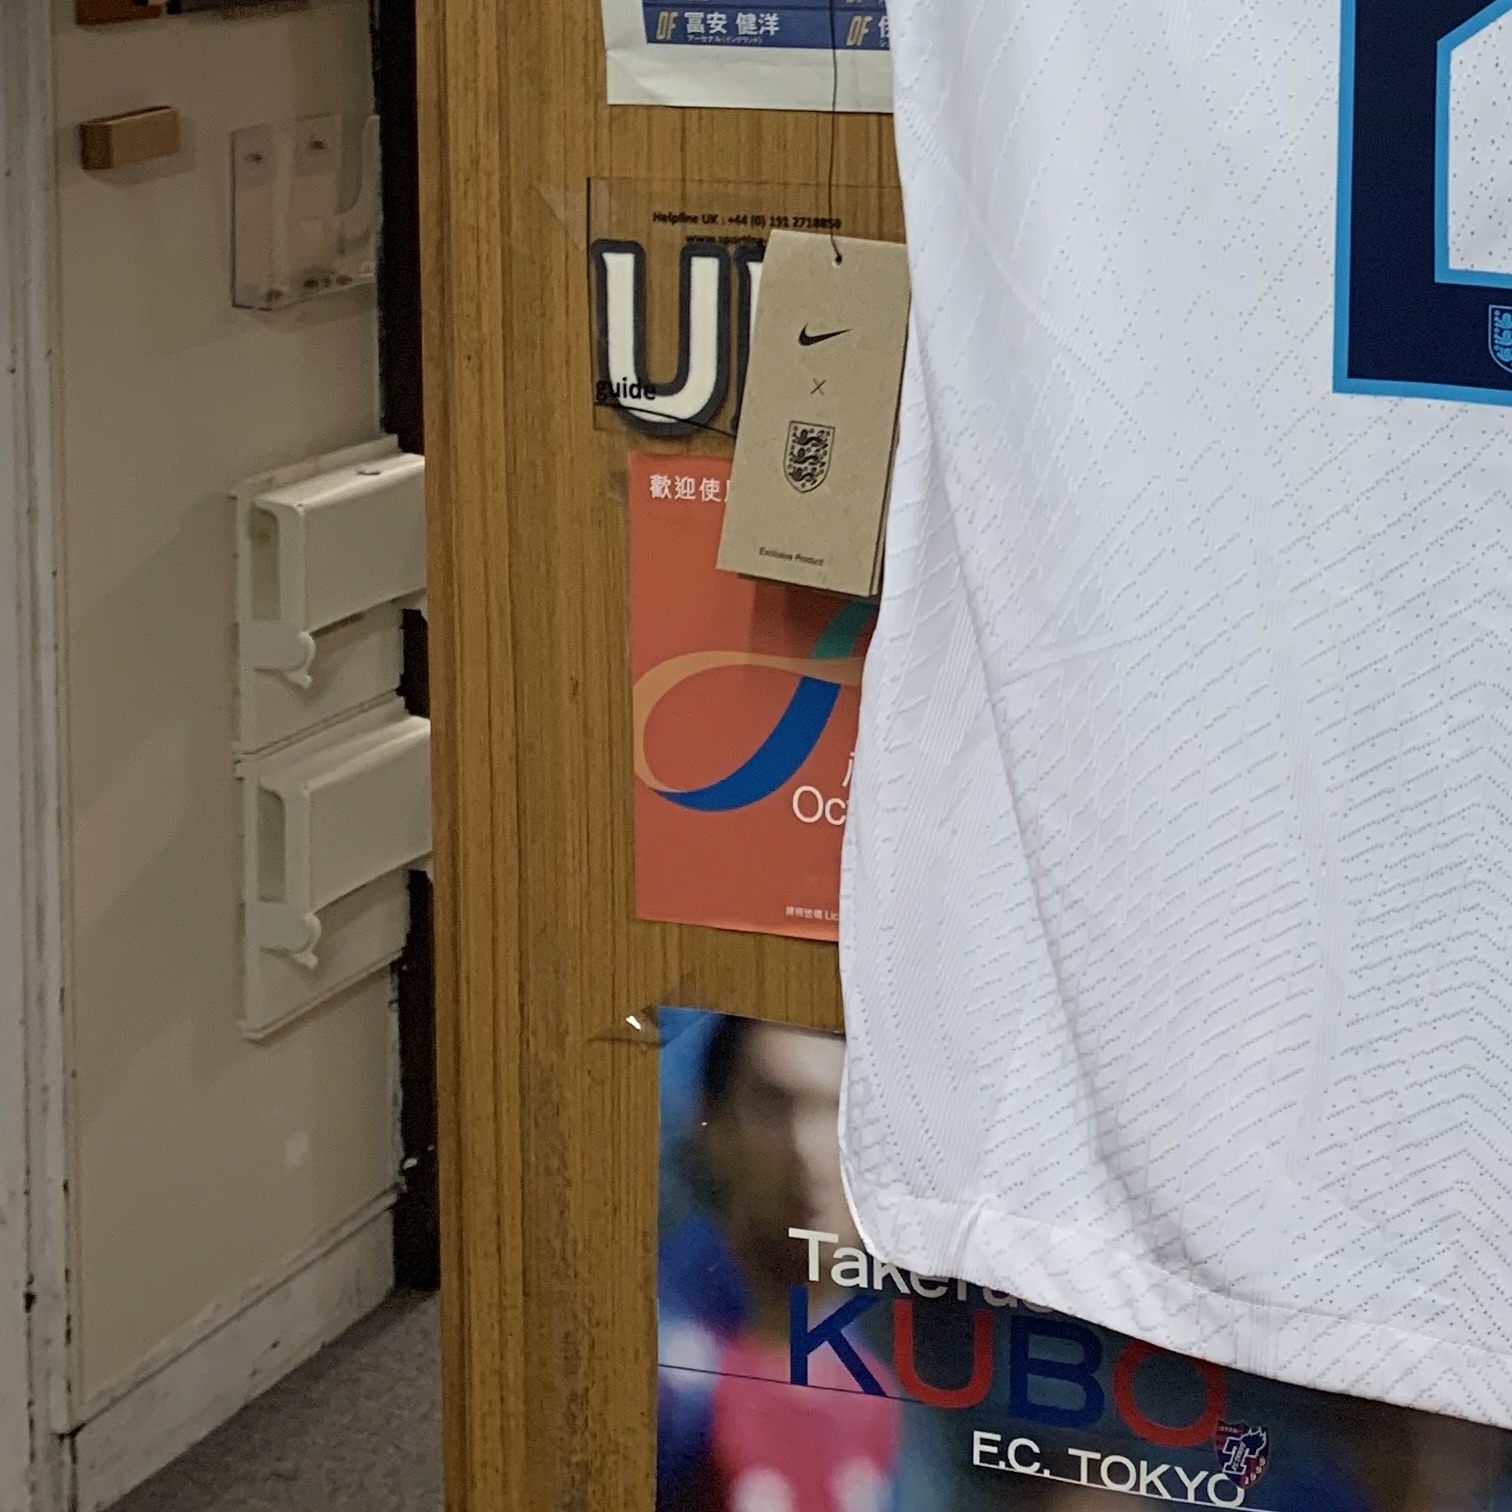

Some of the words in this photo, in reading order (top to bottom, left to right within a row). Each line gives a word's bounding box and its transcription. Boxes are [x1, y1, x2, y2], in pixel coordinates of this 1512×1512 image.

[656, 11, 679, 41] DF
[736, 11, 781, 37] 健洋
[845, 15, 873, 47] DF
[650, 474, 730, 503] 歡迎使
[792, 785, 849, 826] Oc
[788, 1285, 1227, 1447] KUBO
[1068, 1447, 1245, 1508] TOKYO
